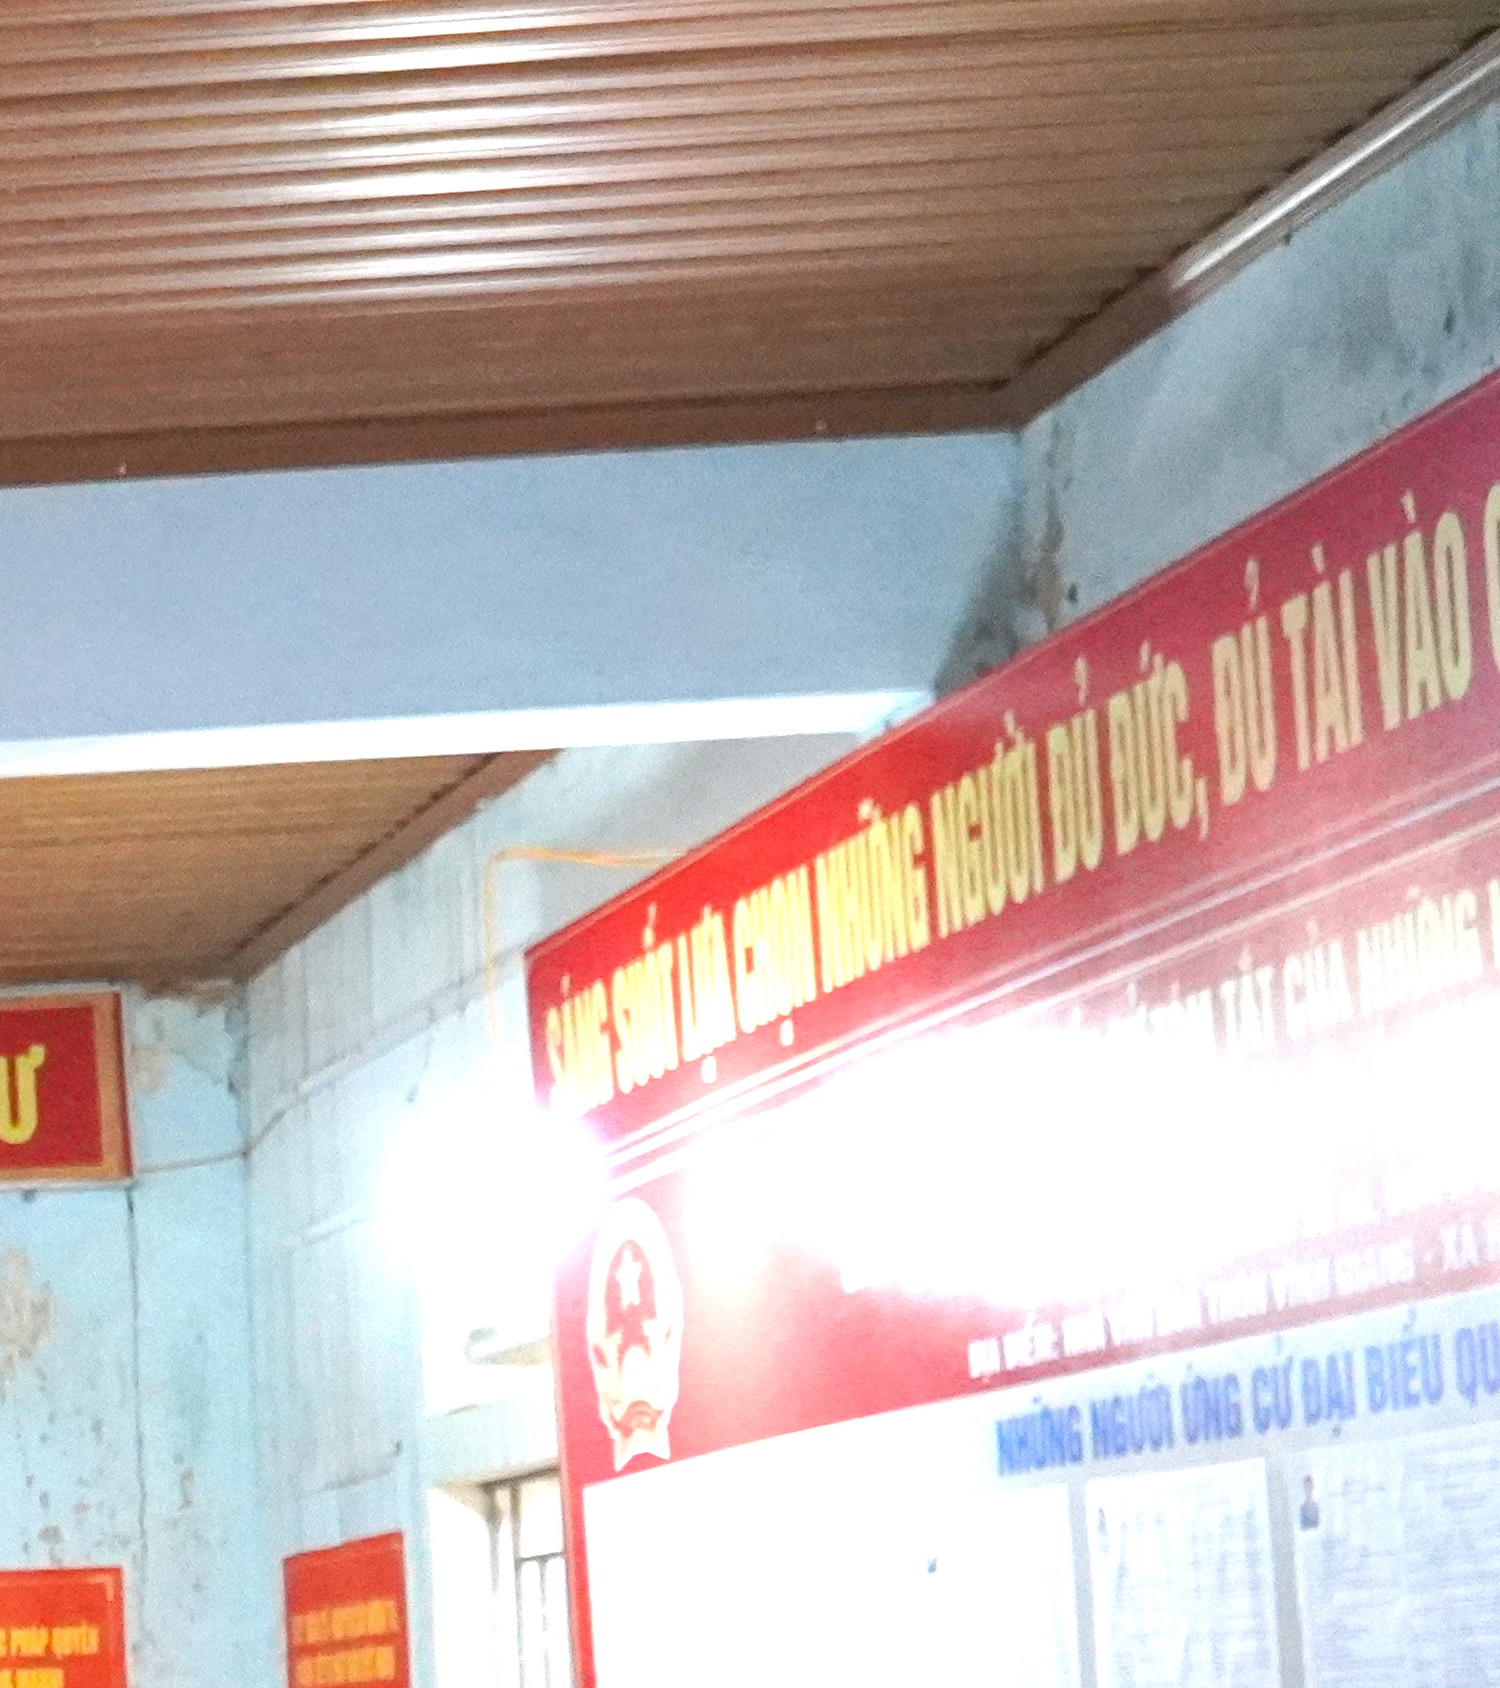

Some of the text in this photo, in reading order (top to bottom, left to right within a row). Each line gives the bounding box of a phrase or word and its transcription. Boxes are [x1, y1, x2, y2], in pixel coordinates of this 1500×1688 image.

[680, 902, 736, 1084] LỰA
[734, 866, 817, 1045] CHỌN
[816, 799, 930, 994] NHỮNG
[930, 711, 1044, 938] NGƯỜI
[1048, 657, 1102, 884] ĐỦ
[1107, 641, 1209, 856] ĐỨC,
[1211, 559, 1276, 806] ĐỦ
[1282, 545, 1363, 770] TÀI
[1367, 489, 1473, 731] VÀO
[996, 1394, 1083, 1476] NHỮNG
[1090, 1373, 1175, 1460] NGƯỜI
[1179, 1362, 1242, 1445] ỨNG
[1251, 1334, 1294, 1434] CỬ
[1302, 1351, 1357, 1437] ĐẠI
[1363, 1306, 1442, 1414] BIỂU
